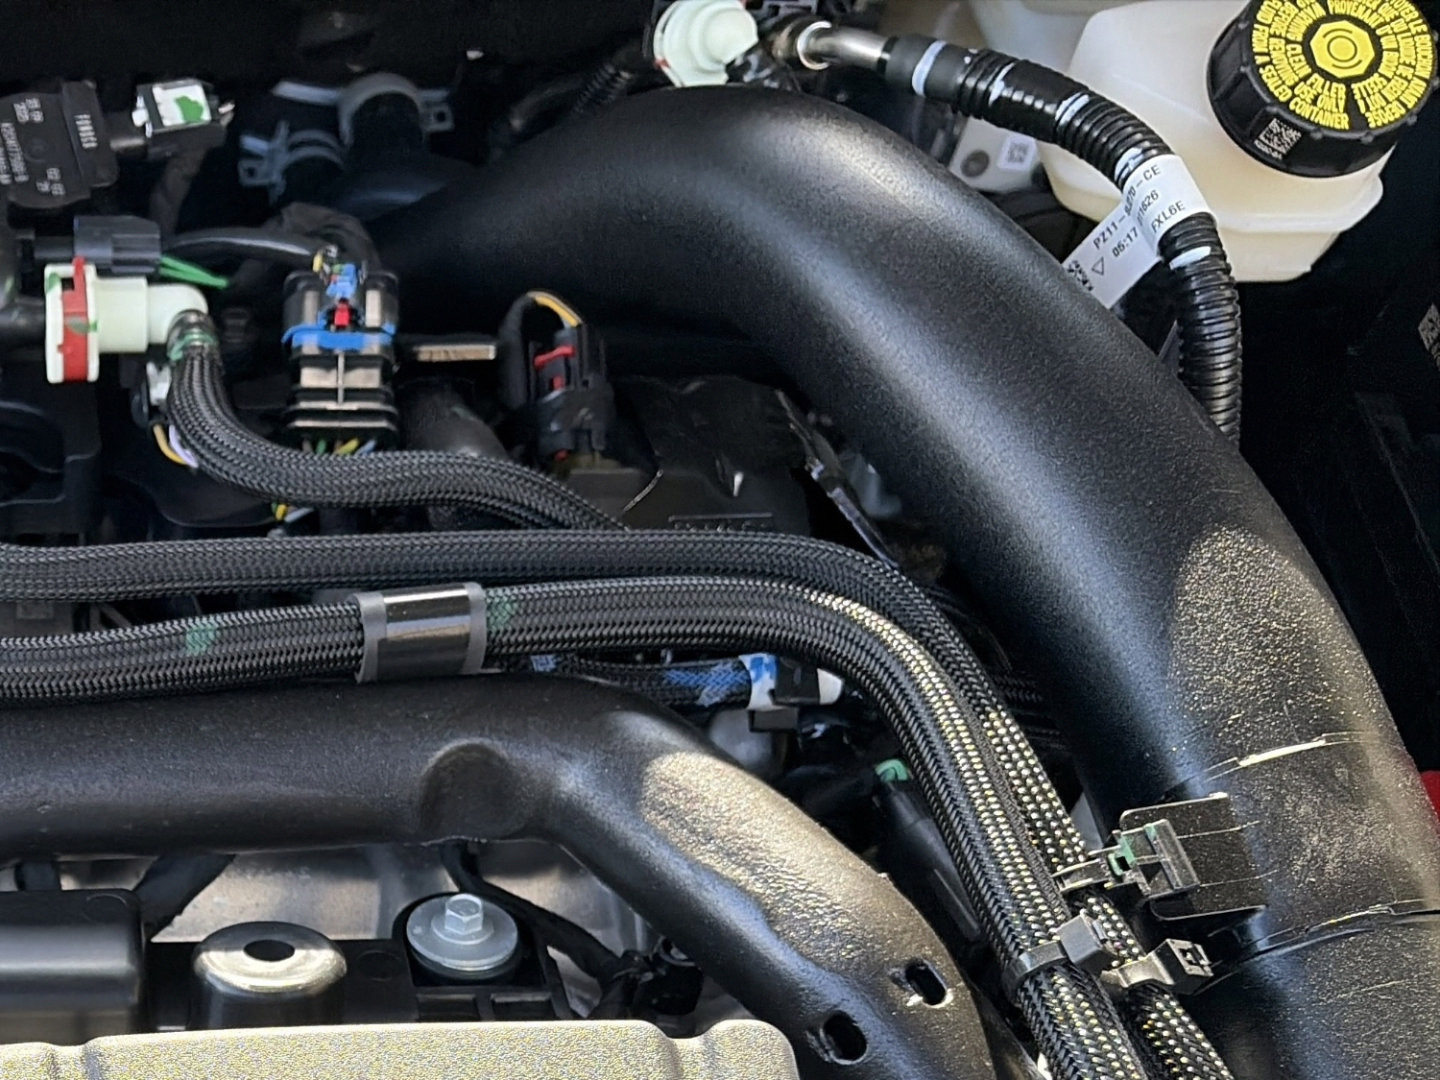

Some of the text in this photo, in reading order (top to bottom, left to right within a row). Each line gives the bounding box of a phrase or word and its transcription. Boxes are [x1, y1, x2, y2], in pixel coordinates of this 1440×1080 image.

[1285, 1, 1327, 42] WARNING
[1408, 19, 1428, 35] LE
[1254, 54, 1270, 65] A
[1269, 1, 1346, 114] BEFORE REMOVING USE ONLY
[1285, 43, 1312, 79] CLEAN
[1395, 64, 1415, 80] DE
[1413, 34, 1433, 79] BOUCHON
[1259, 65, 1292, 102] SEALED
[1306, 72, 1346, 99] FILLER
[1399, 77, 1427, 109] AVANT
[1289, 97, 1350, 130] CONTAINER
